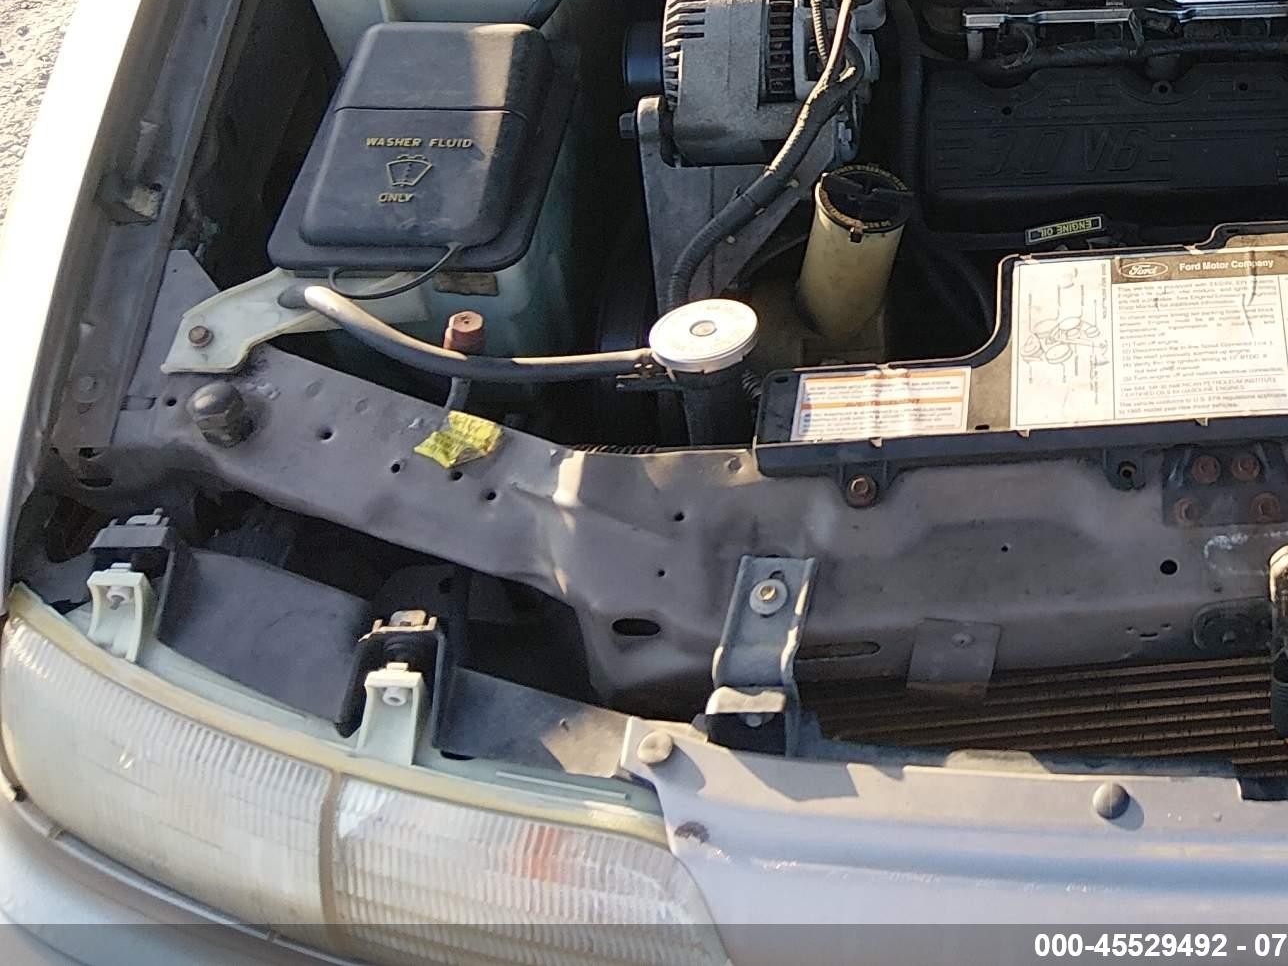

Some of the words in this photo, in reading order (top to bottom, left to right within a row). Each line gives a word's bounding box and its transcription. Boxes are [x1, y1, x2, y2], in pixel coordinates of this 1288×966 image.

[366, 137, 422, 148] WASHER
[428, 137, 473, 149] FLUID
[378, 192, 415, 203] ONLY
[1055, 218, 1092, 233] ENGINE
[1039, 226, 1054, 238] OIL
[1128, 264, 1157, 275] Ford
[1179, 262, 1201, 272] Ford
[1202, 261, 1229, 270] Motor
[1231, 259, 1274, 269] Company
